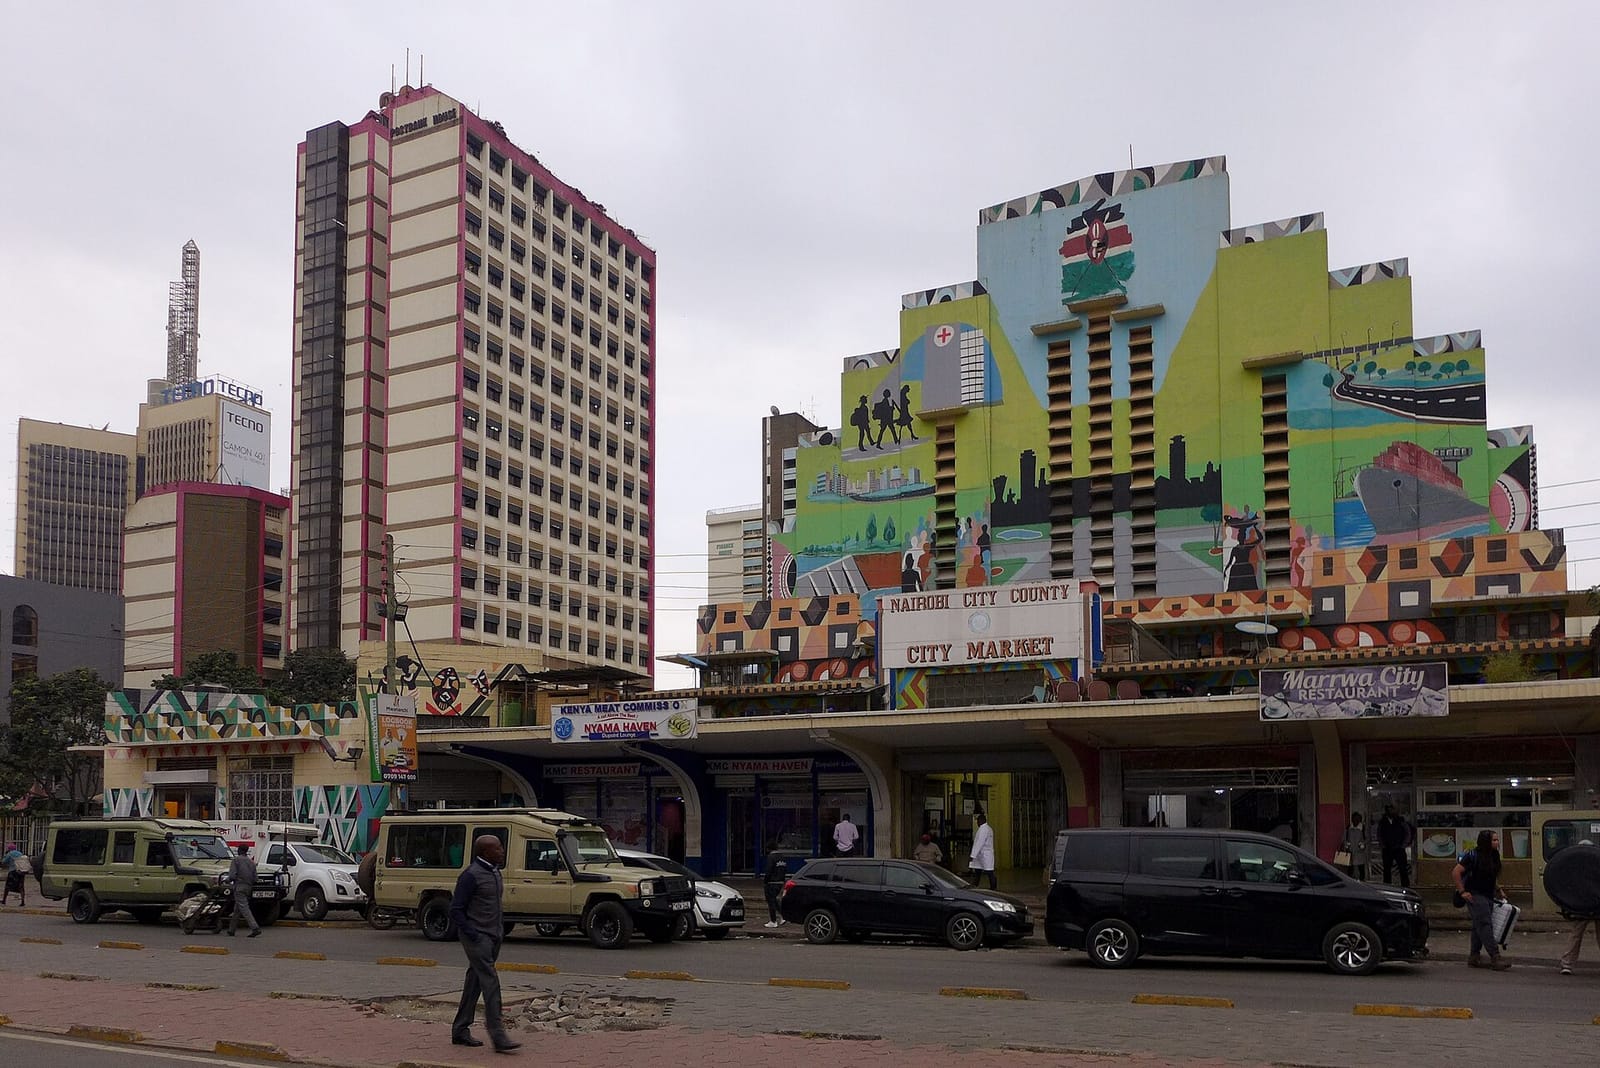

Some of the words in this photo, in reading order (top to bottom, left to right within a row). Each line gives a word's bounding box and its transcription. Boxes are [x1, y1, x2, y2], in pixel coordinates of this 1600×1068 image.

[390, 117, 427, 138] POSTBANK
[432, 108, 456, 125] HOUSE
[217, 379, 263, 406] TECNO
[227, 411, 263, 433] TECNO
[223, 440, 253, 457] CAMON
[890, 594, 950, 613] NAIROBI
[962, 590, 997, 608] CITY
[1010, 584, 1070, 603] COUNTY
[907, 643, 952, 663] CITY
[966, 637, 1054, 660] MARKET
[1282, 669, 1376, 690] Marrwa
[1379, 665, 1425, 691] City
[1298, 685, 1401, 701] RESTAURANT
[560, 704, 593, 714] KENYA
[594, 703, 621, 713] MEAT
[584, 723, 620, 734] NYAMA
[623, 721, 657, 732] HAVEN
[570, 765, 638, 775] RESTAURANT
[732, 761, 768, 770] NYAMA
[773, 760, 808, 770] HAVEN
